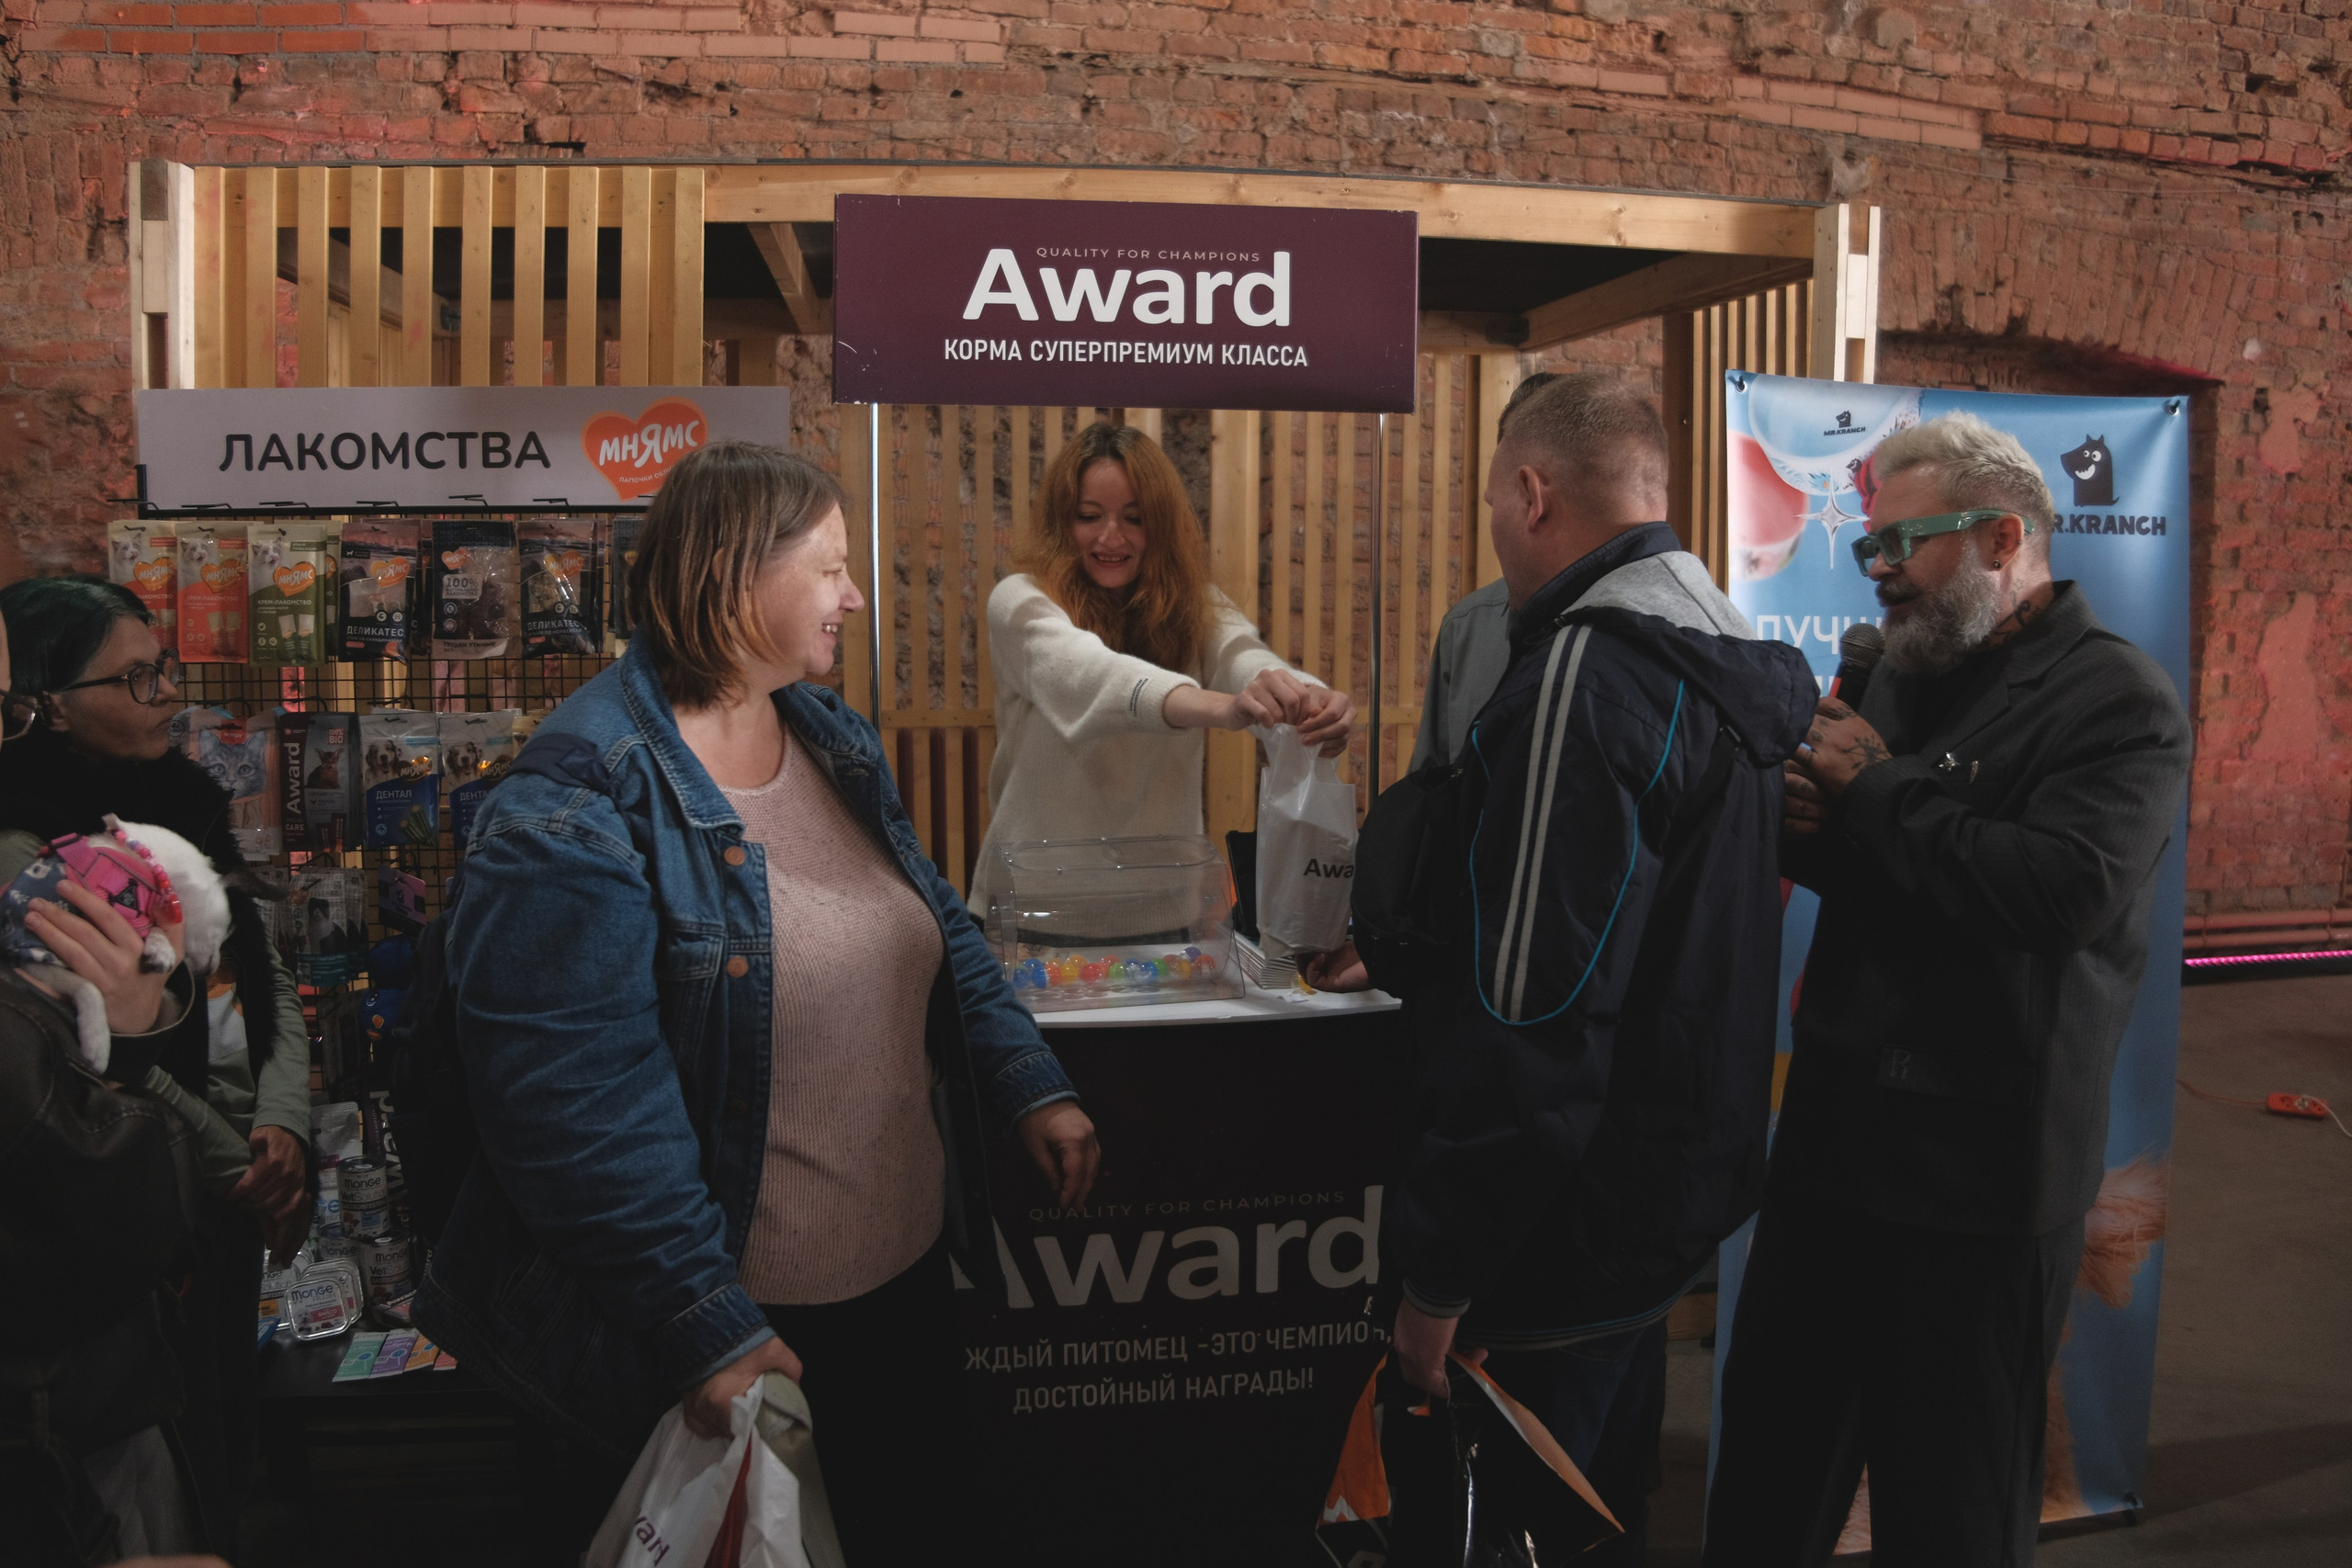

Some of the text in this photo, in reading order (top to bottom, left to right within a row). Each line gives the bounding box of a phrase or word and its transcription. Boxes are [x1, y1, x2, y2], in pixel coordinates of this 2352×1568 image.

[1036, 247, 1260, 262] QUALITY FOR CHAMPIONS
[963, 248, 1291, 327] Award
[944, 338, 1308, 367] КОРМА СУПЕРПРЕМИУМ КЛАССА
[1823, 426, 1866, 436] MR.KRANCH
[219, 431, 551, 471] ЛАКОМСТВА
[618, 467, 673, 483] ЛАПОЧКИ ОБЛИ
[2051, 513, 2166, 536] R.KRANCH
[446, 578, 478, 588] 100%
[346, 626, 404, 637] ДЕЛИКАТЕС
[527, 619, 580, 631] ДЕЛИКАТЕС
[1757, 615, 1883, 655] ЛУЧ
[329, 735, 344, 744] BIO
[284, 742, 301, 815] Award
[376, 790, 412, 800] ДЕНТАЛ
[460, 791, 489, 802] ДЕНТА
[285, 823, 305, 831] CARE
[1303, 858, 1355, 878] Awa
[1029, 1190, 1345, 1223] QUALITY FOR CHAMPIONS
[263, 1270, 283, 1280] nge
[965, 1337, 1053, 1373] ЖДЫЙ
[1063, 1335, 1188, 1367] ПИТОМЕЦ
[1013, 1366, 1314, 1415] ДОСТОЙНЫЙ НАГРАДЫ!
